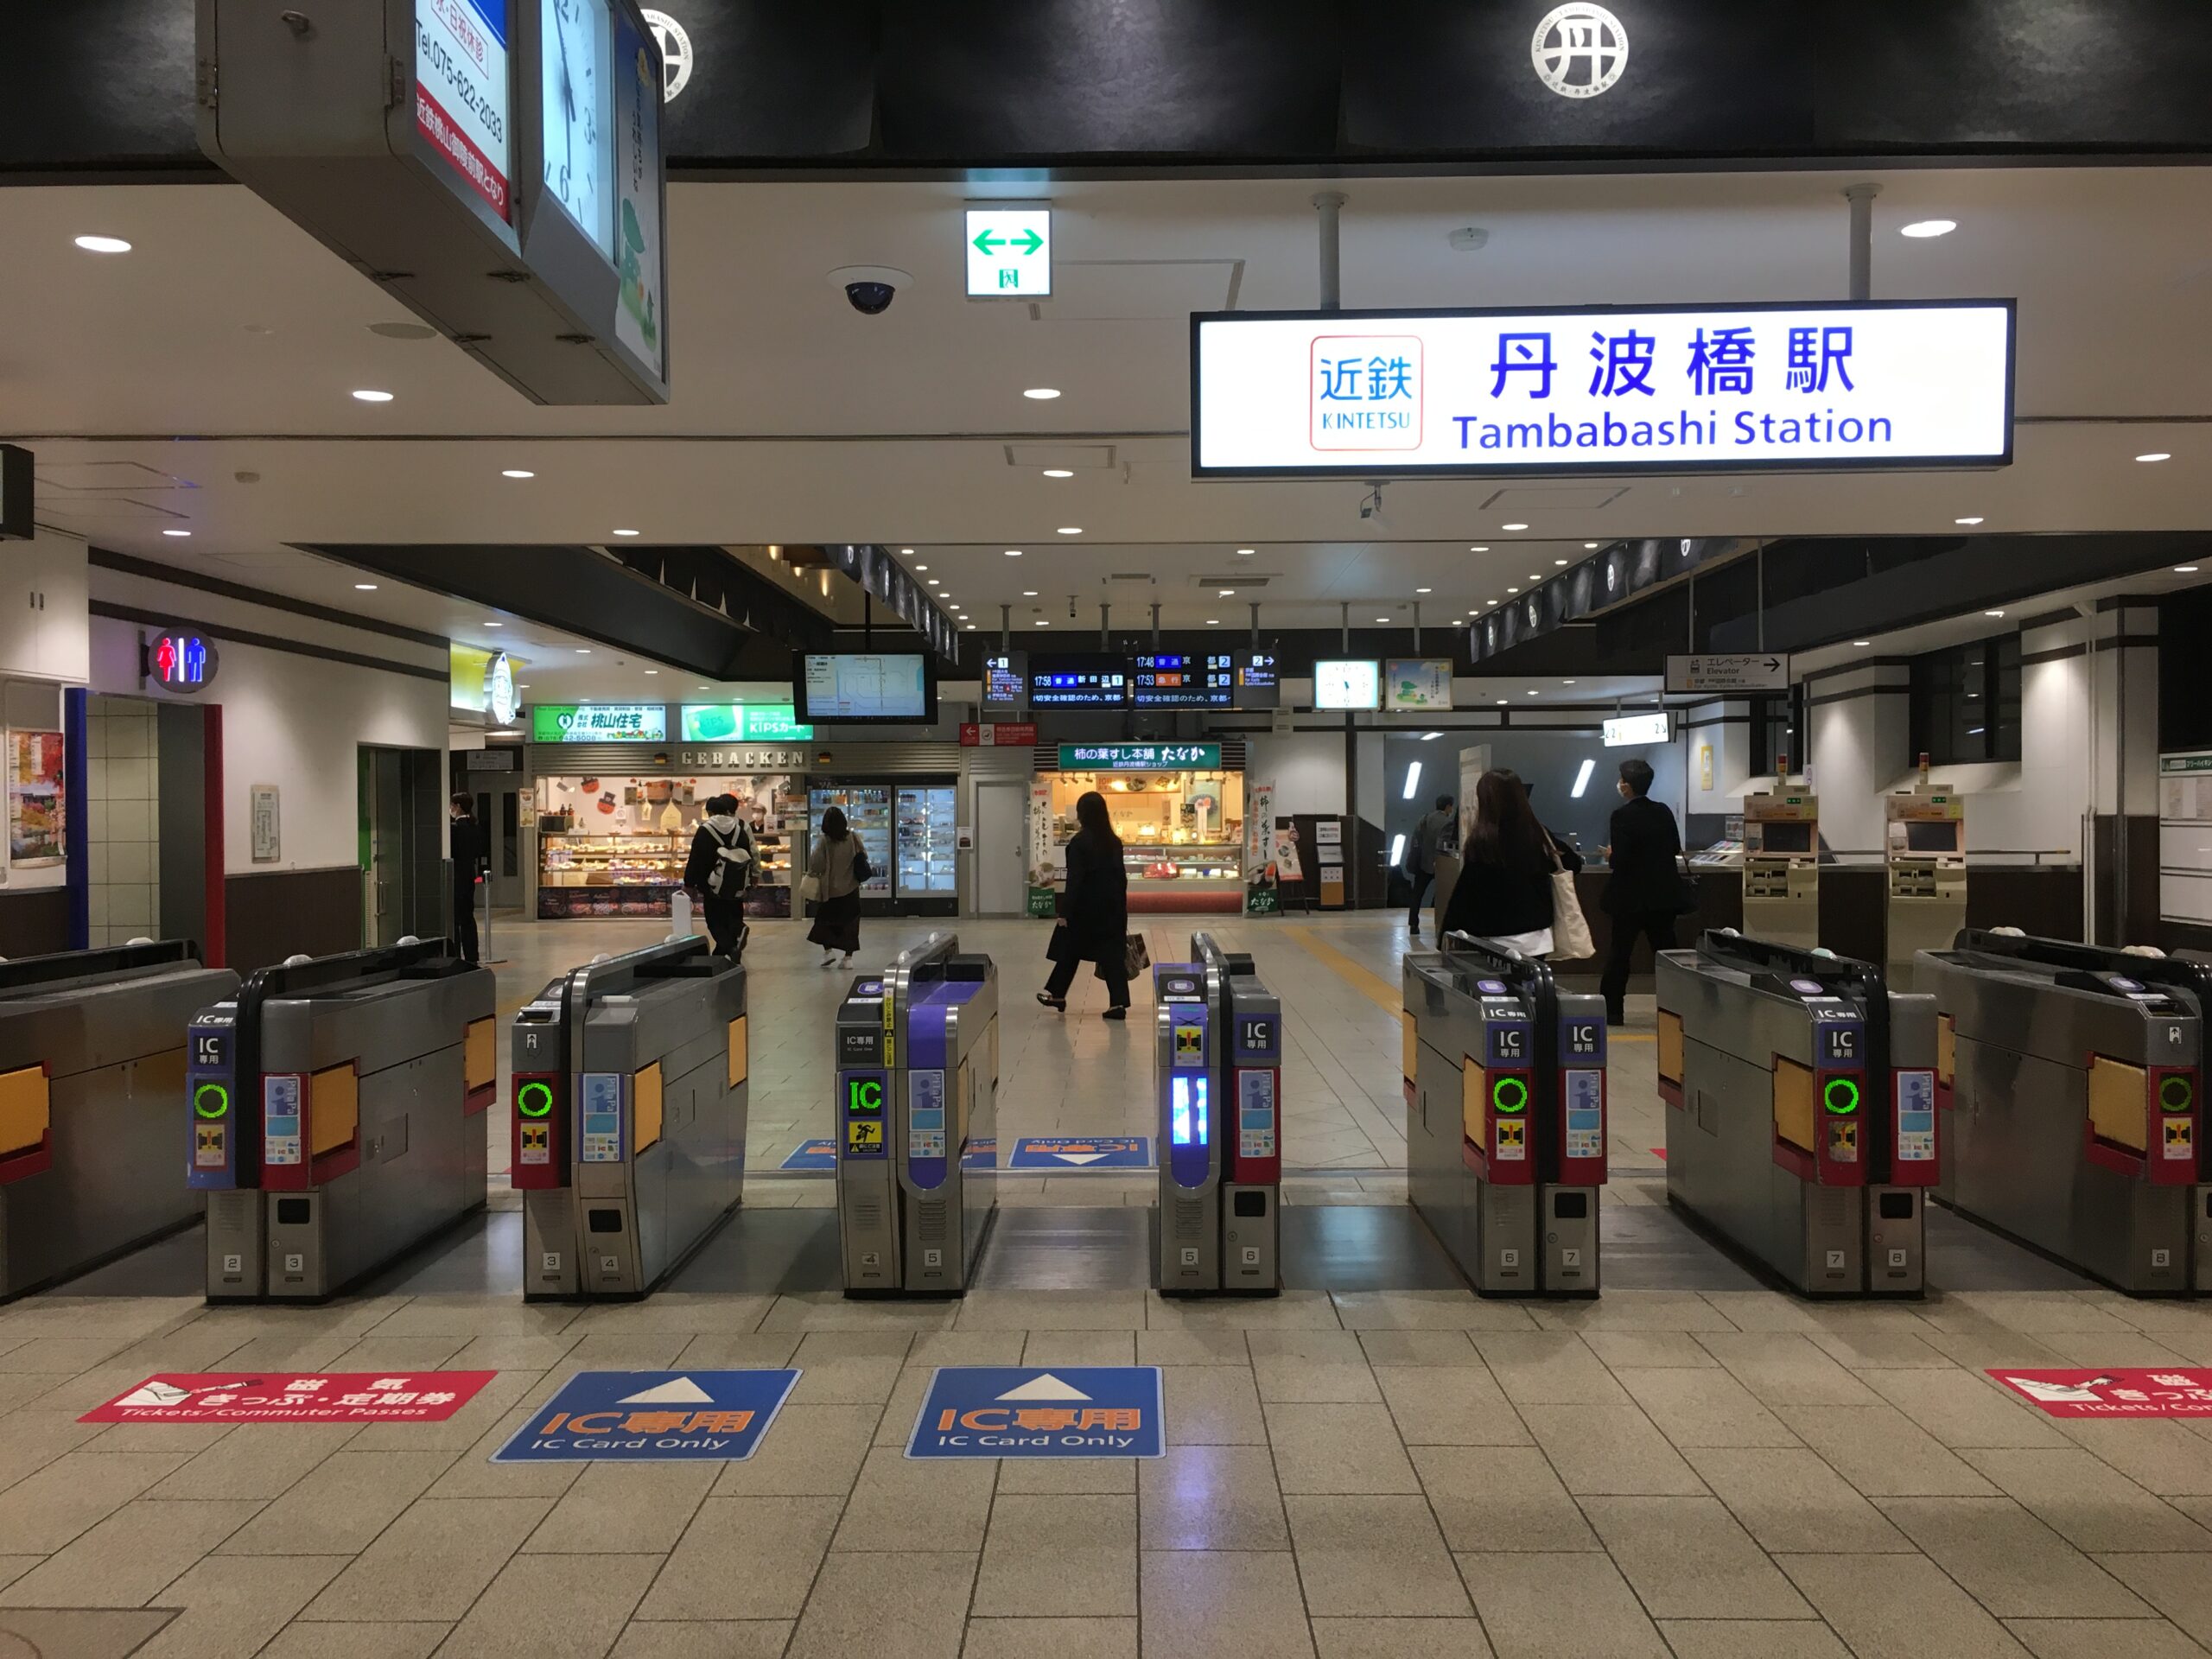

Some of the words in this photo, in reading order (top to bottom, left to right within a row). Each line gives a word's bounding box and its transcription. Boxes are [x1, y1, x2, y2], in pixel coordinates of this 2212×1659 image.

[416, 18, 503, 144] Tel.075-622-2033
[1490, 326, 1855, 399] 丹波橋駅
[1320, 355, 1412, 401] 近鉄
[1322, 410, 1410, 429] KINTETSU
[1452, 409, 1717, 449] Tambabashi
[1733, 407, 1892, 445] Station
[1136, 656, 1155, 668] 17:48
[1707, 657, 1760, 666] エレベーター
[1136, 674, 1155, 686] 17:53
[1033, 693, 1124, 702] 切安全確認のため、京都
[1135, 694, 1231, 702] 切安全確認のため、京都
[591, 713, 643, 728] 桃山住宅
[681, 751, 804, 765] GEBACKEN
[1074, 747, 1155, 760] 柿の葉すし本舗
[1161, 746, 1205, 762] たなか
[1247, 1022, 1267, 1039] IC
[1573, 1026, 1593, 1042] IC
[199, 1037, 219, 1053] IC
[846, 1036, 874, 1046] IC専用
[1247, 1040, 1267, 1050] 専用
[1500, 1031, 1520, 1047] IC
[1833, 1031, 1853, 1047] IC
[1500, 1048, 1520, 1058] 専用
[1573, 1043, 1594, 1053] 専用
[1833, 1048, 1853, 1058] 専用
[199, 1055, 219, 1065] 専用
[849, 1081, 882, 1109] IC
[197, 1392, 458, 1408] きっぷ・定期券
[120, 1408, 344, 1418] Tickets/Commuter
[350, 1408, 428, 1418] Passes
[937, 1408, 1141, 1431] IC専用
[539, 1410, 755, 1435] IC専用
[531, 1440, 565, 1450] IC
[572, 1437, 647, 1450] Card
[656, 1437, 731, 1450] Only
[938, 1436, 969, 1446] IC
[978, 1435, 1050, 1446] Card
[1061, 1435, 1134, 1447] Only
